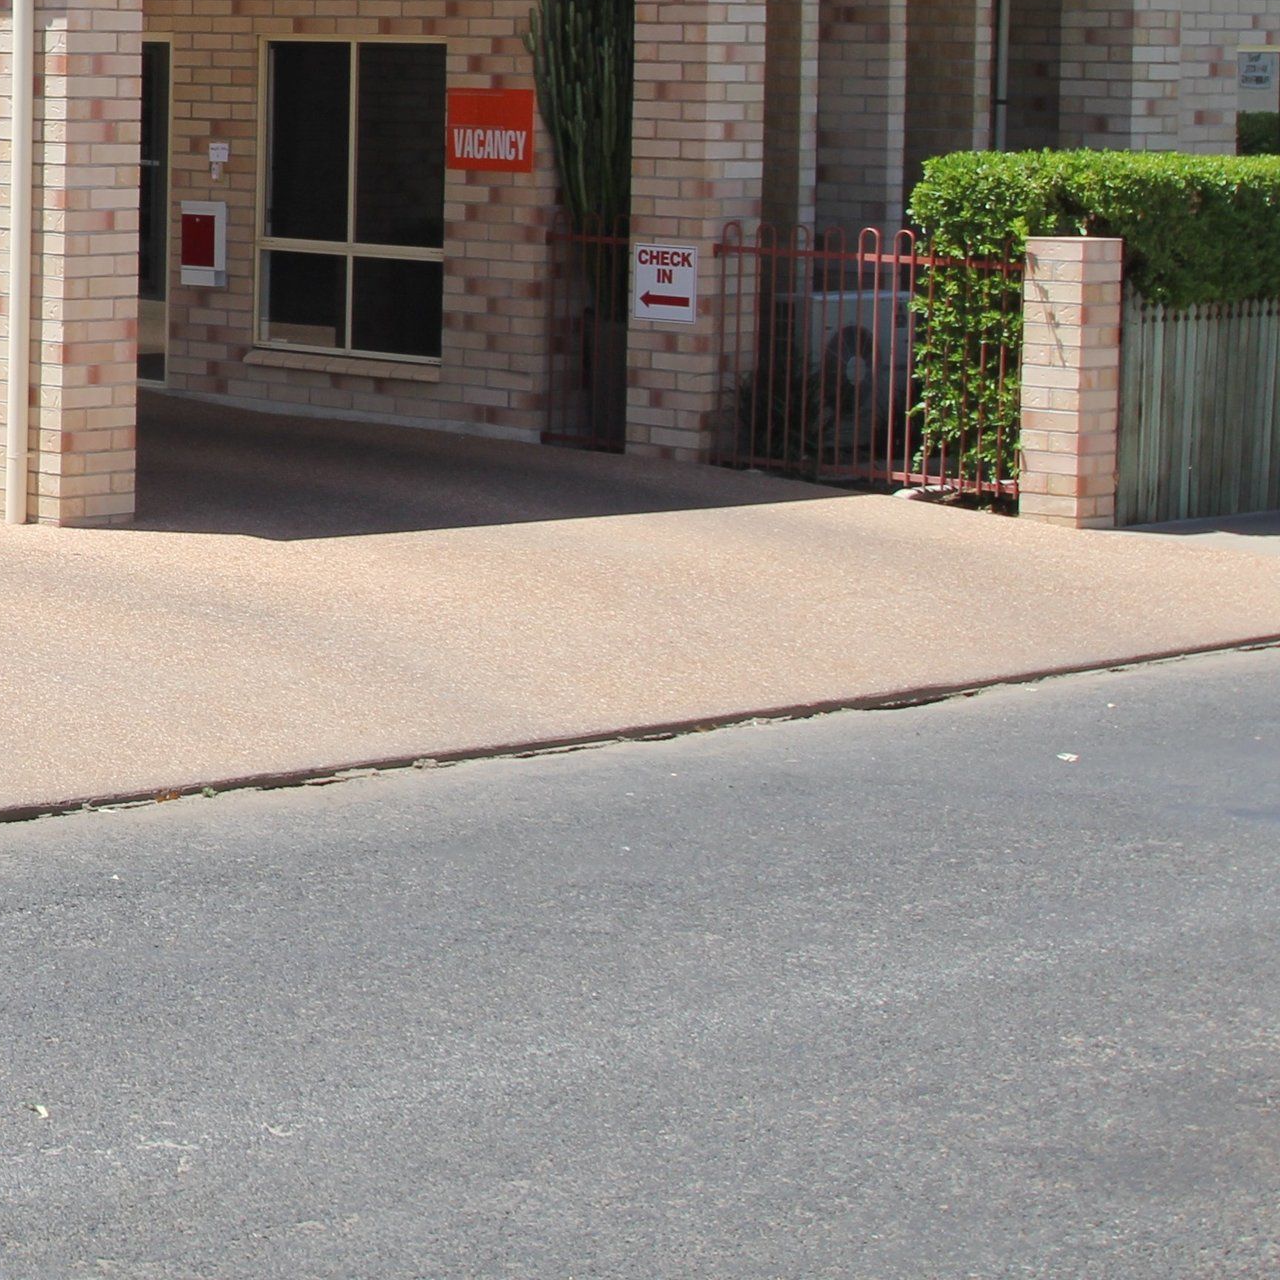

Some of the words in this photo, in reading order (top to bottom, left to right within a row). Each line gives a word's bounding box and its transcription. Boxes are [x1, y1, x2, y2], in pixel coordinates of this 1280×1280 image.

[453, 128, 527, 161] VACANCY
[638, 249, 692, 268] CHECK
[656, 268, 673, 284] IN
